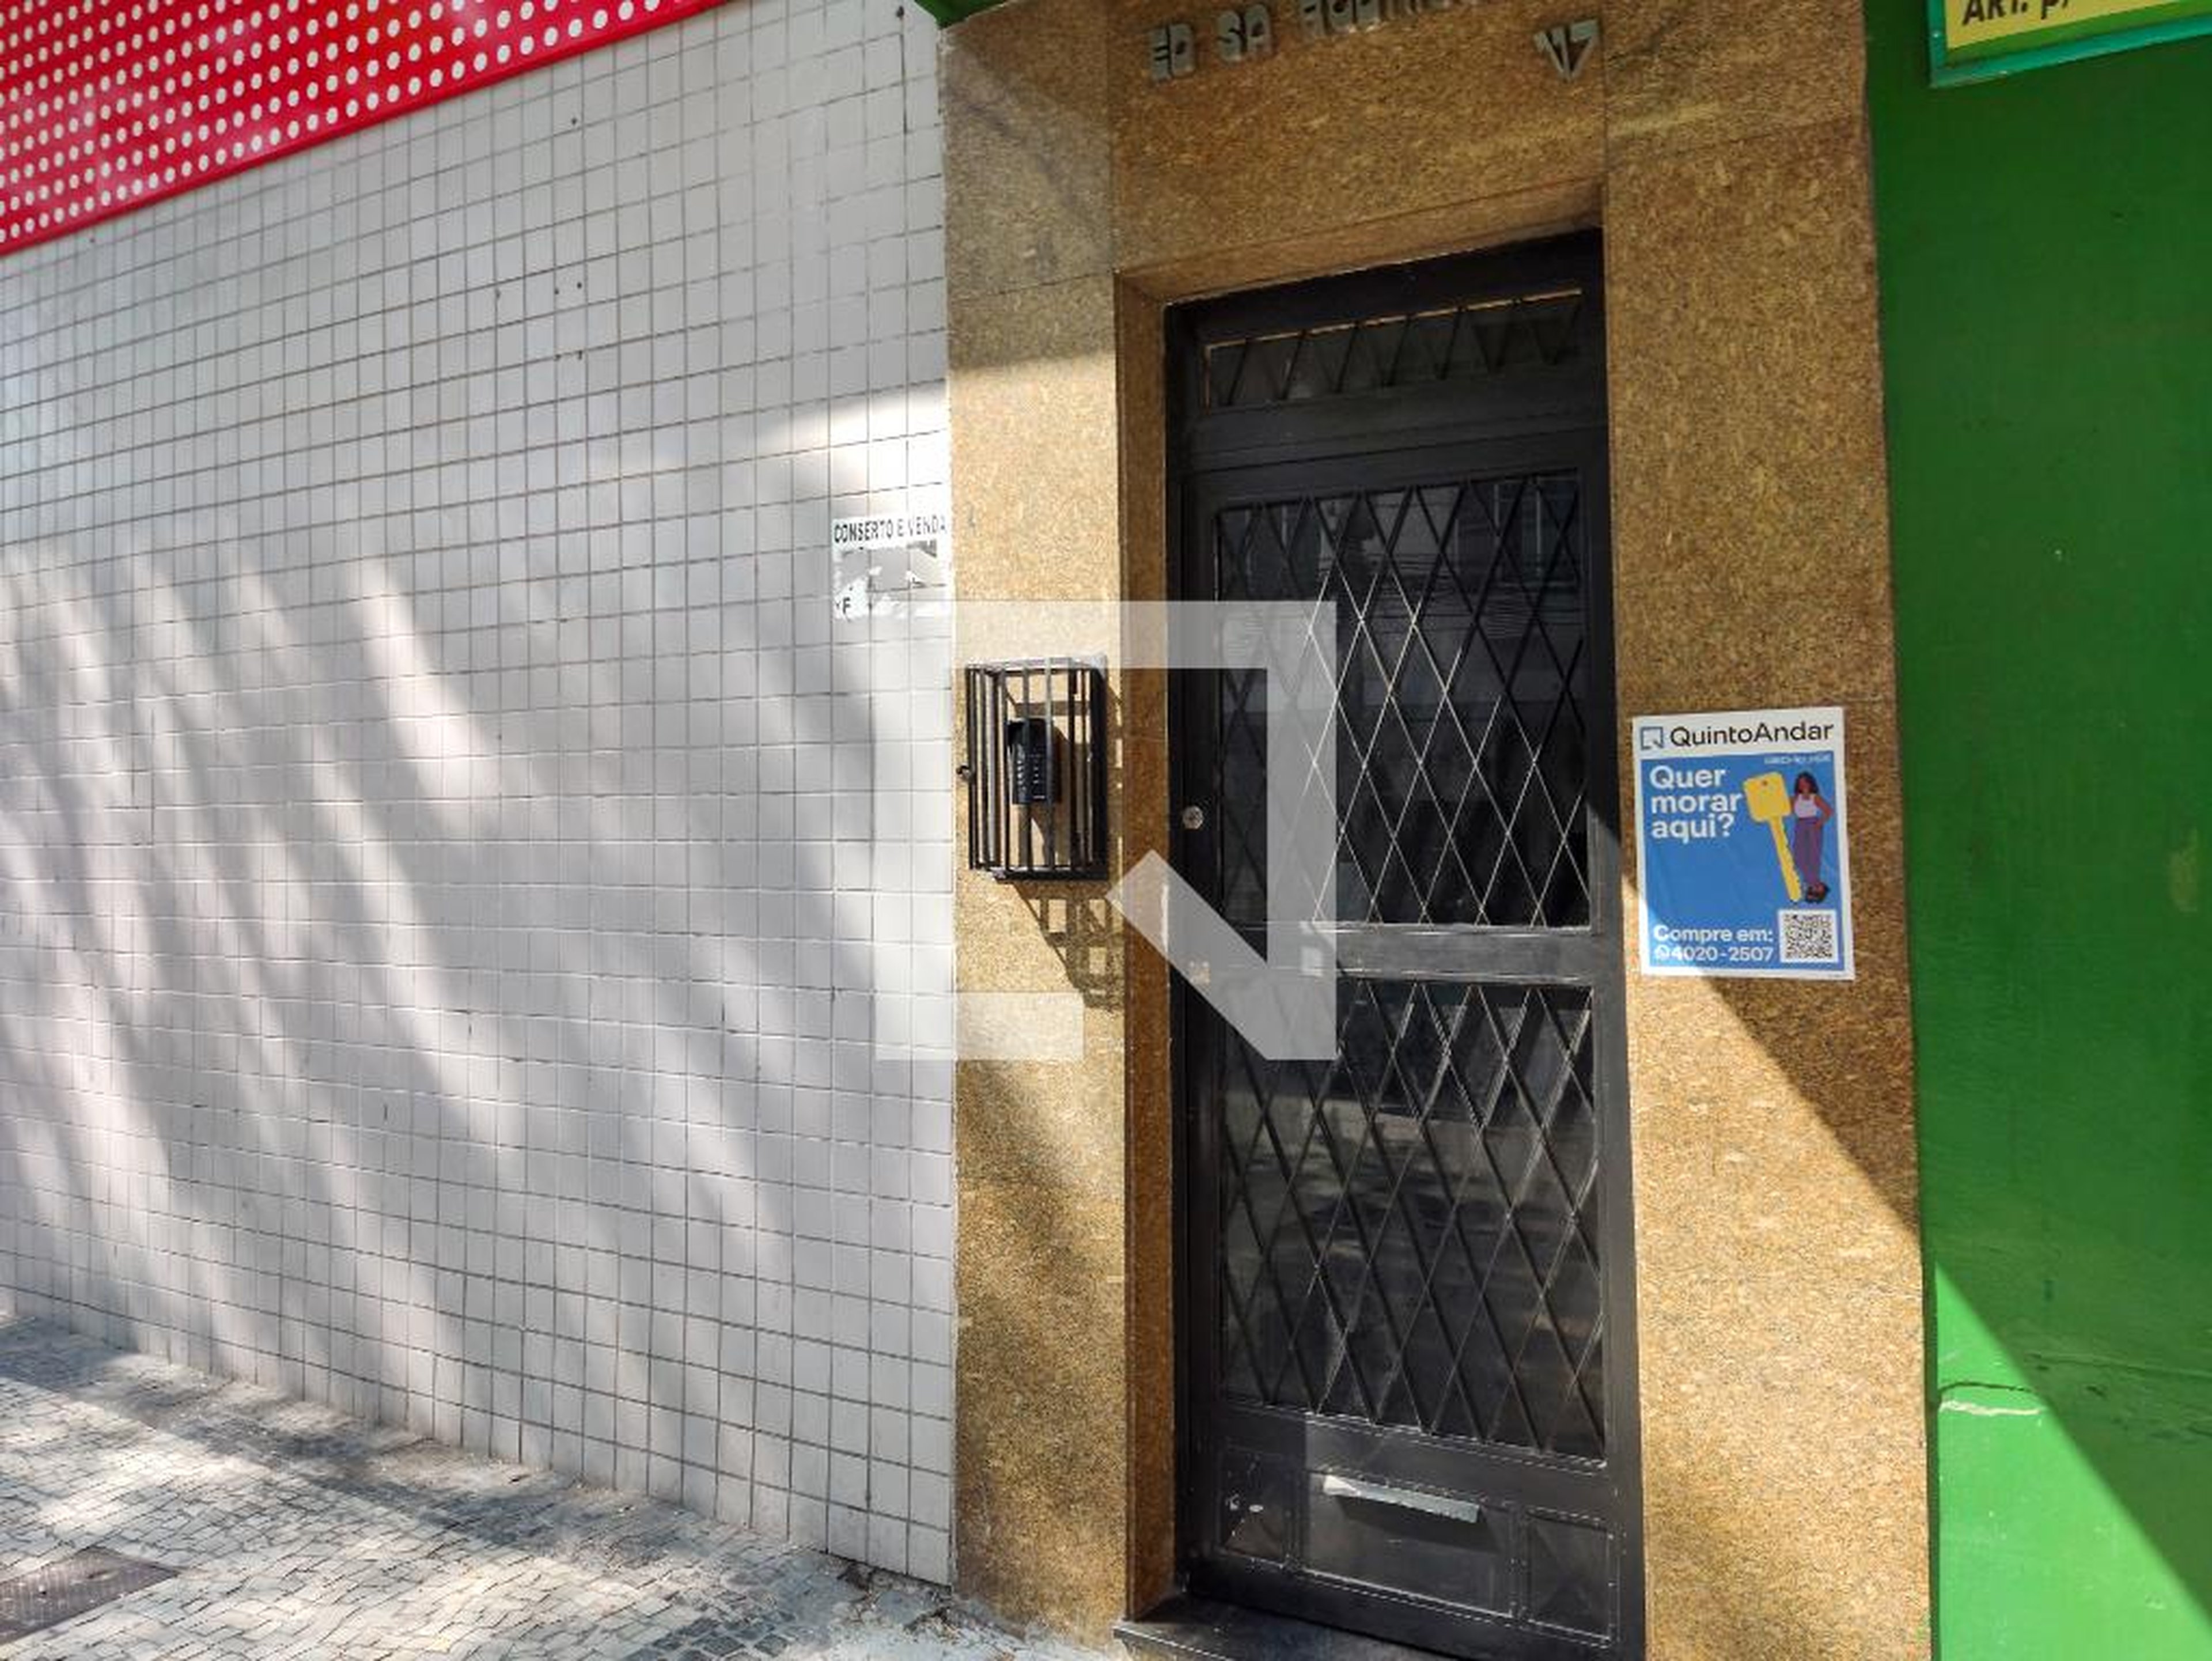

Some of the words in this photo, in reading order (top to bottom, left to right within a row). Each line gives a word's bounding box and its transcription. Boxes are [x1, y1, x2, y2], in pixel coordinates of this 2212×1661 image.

[834, 519, 893, 543] CONSERTO
[896, 519, 904, 537] E
[1670, 721, 1834, 748] QuintoAndar
[1650, 764, 1727, 790] Quer
[1651, 791, 1743, 814] morar
[1651, 813, 1735, 845] aqui?
[1653, 924, 1733, 944] Compre
[1736, 928, 1774, 942] em:
[1670, 946, 1774, 962] 4020-2507
